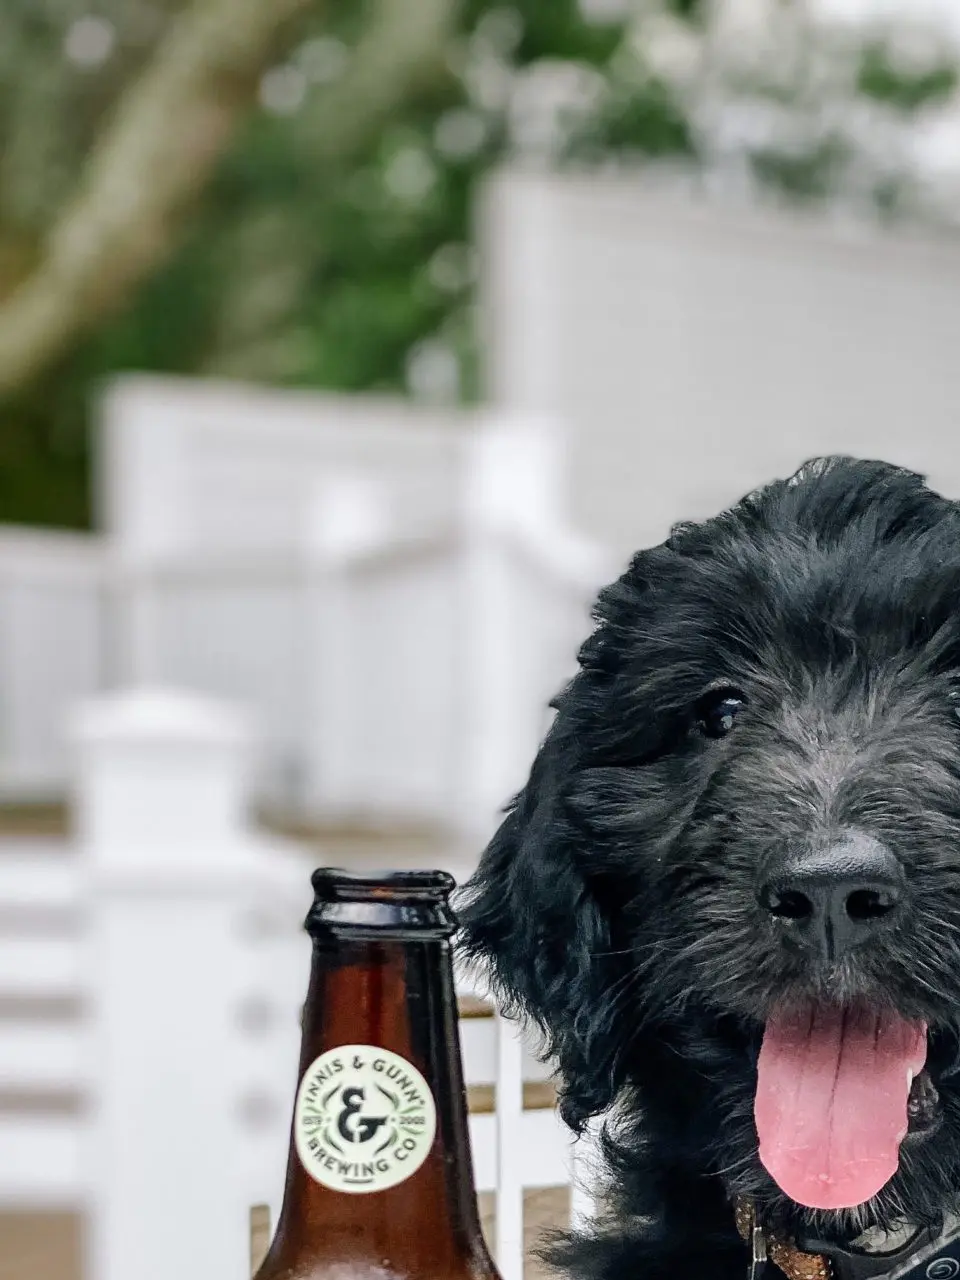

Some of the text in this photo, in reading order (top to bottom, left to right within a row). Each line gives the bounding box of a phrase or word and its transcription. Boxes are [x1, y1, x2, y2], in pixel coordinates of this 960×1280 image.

[305, 1058, 344, 1103] INNIS
[352, 1055, 366, 1070] &
[338, 1086, 389, 1143] &
[308, 1137, 417, 1177] BREWING CO
